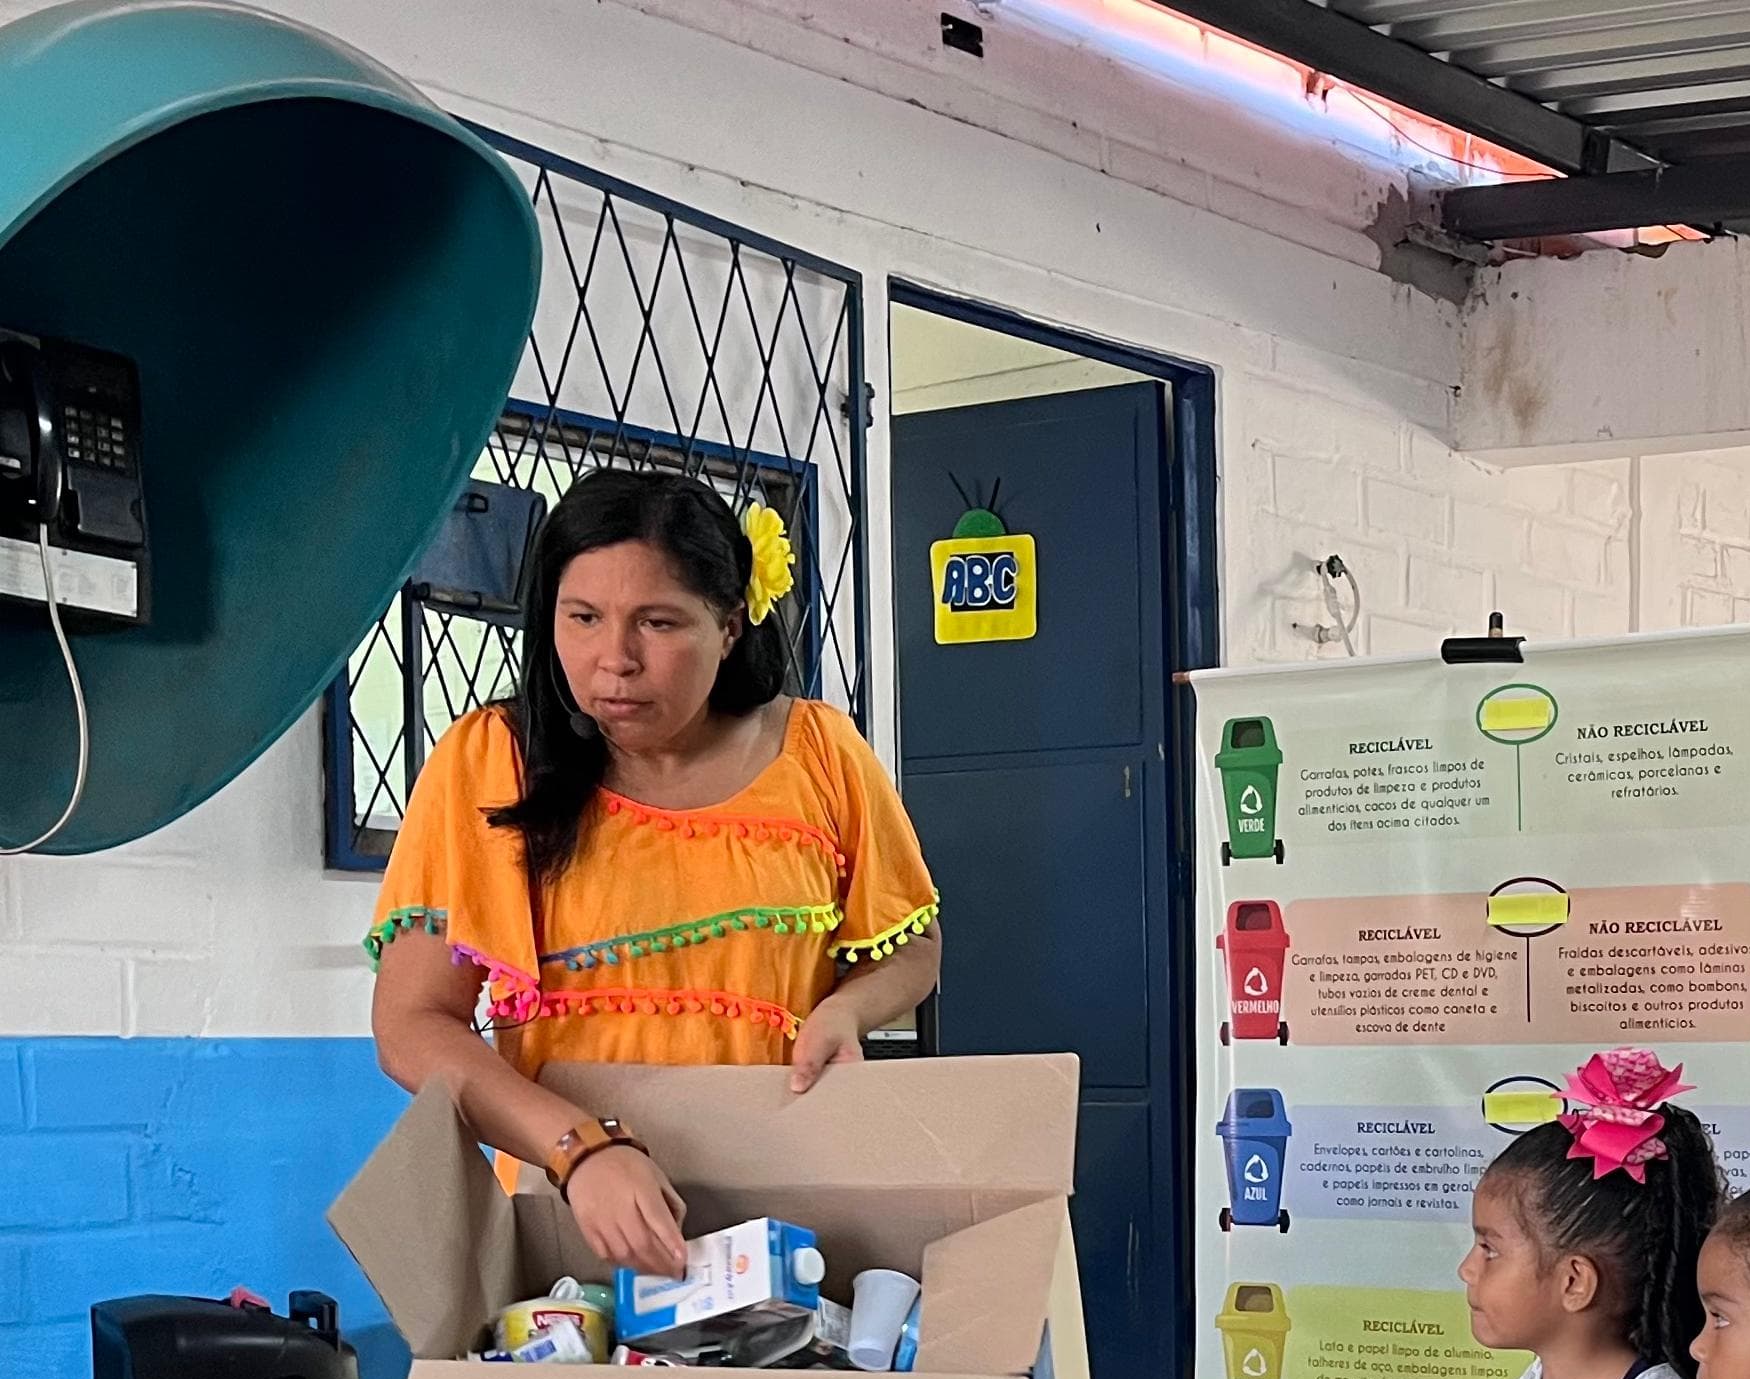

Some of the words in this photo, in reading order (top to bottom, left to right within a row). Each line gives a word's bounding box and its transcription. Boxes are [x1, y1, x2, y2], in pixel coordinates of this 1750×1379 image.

[942, 555, 1018, 606] ABC
[1577, 725, 1608, 739] NÃO
[1614, 718, 1708, 737] RECICLÁVEL
[1349, 737, 1432, 754] RECICLÁVEL
[1555, 753, 1603, 765] Cristais,
[1608, 748, 1664, 762] espelhos,
[1669, 744, 1733, 758] lâmpadas,
[1388, 763, 1428, 776] frascos
[1432, 761, 1466, 775] limpos
[1471, 759, 1485, 770] de
[1568, 771, 1634, 782] cerâmicas,
[1639, 765, 1709, 780] porcelanas
[1714, 766, 1721, 774] e
[1305, 785, 1353, 799] produtos
[1357, 785, 1369, 795] de
[1374, 782, 1415, 794] limpeza
[1421, 783, 1427, 792] e
[1432, 778, 1481, 792] produtos
[1365, 801, 1396, 811] cacos
[1401, 798, 1416, 810] de
[1421, 797, 1471, 811] qualquer
[1476, 796, 1490, 806] um
[1238, 818, 1265, 833] VERDE
[1328, 821, 1346, 831] dos
[1377, 817, 1409, 828] acima
[1590, 921, 1619, 935] NÃO
[1626, 918, 1722, 933] RECICLÁVEL
[1358, 926, 1441, 942] RECICLÁVEL
[1384, 950, 1452, 964] embalagens
[1457, 950, 1470, 962] de
[1476, 950, 1518, 964] higiene
[1558, 947, 1603, 959] Fraldas
[1310, 973, 1315, 982] e
[1416, 968, 1437, 980] PET,
[1442, 968, 1458, 980] CD
[1462, 970, 1468, 978] e
[1567, 968, 1575, 977] e
[1580, 964, 1655, 977] embalagens
[1661, 965, 1695, 974] como
[1700, 962, 1745, 974] lâminas
[1318, 988, 1346, 999] tubos
[1350, 988, 1382, 998] vazios
[1386, 987, 1396, 998] de
[1402, 988, 1436, 997] creme
[1440, 986, 1478, 996] dental
[1482, 987, 1488, 996] e
[1650, 983, 1684, 992] como
[1689, 981, 1747, 992] bombons,
[1232, 1000, 1278, 1014] VERMELHO
[1360, 1004, 1404, 1017] plásticos
[1409, 1004, 1439, 1014] como
[1444, 1004, 1485, 1014] caneta
[1490, 1004, 1497, 1014] e
[1570, 1001, 1627, 1013] biscoitos
[1632, 1002, 1638, 1011] e
[1644, 999, 1683, 1010] outros
[1689, 999, 1744, 1011] produtos
[1356, 1022, 1392, 1032] escova
[1397, 1021, 1409, 1032] de
[1412, 1022, 1446, 1032] dente
[1357, 1120, 1435, 1134] RECICLÁVEL
[1372, 1146, 1411, 1157] cartões
[1415, 1148, 1421, 1157] e
[1394, 1163, 1408, 1173] de
[1412, 1164, 1460, 1175] embrulho
[1244, 1187, 1267, 1201] AZUL
[1323, 1181, 1328, 1189] e
[1373, 1181, 1420, 1193] impressos
[1424, 1182, 1438, 1191] em
[1336, 1197, 1364, 1206] como
[1368, 1197, 1402, 1209] jornais
[1406, 1199, 1412, 1208] e
[1363, 1319, 1444, 1336] RECICLÁVEL
[1320, 1340, 1344, 1352] Lata
[1348, 1344, 1354, 1352] e
[1358, 1343, 1389, 1356] papel
[1392, 1344, 1420, 1357] limpo
[1424, 1346, 1438, 1356] de
[1308, 1358, 1349, 1370] talheres
[1354, 1360, 1367, 1370] de
[1397, 1363, 1466, 1377] embalagens
[1471, 1364, 1508, 1378] limpas
